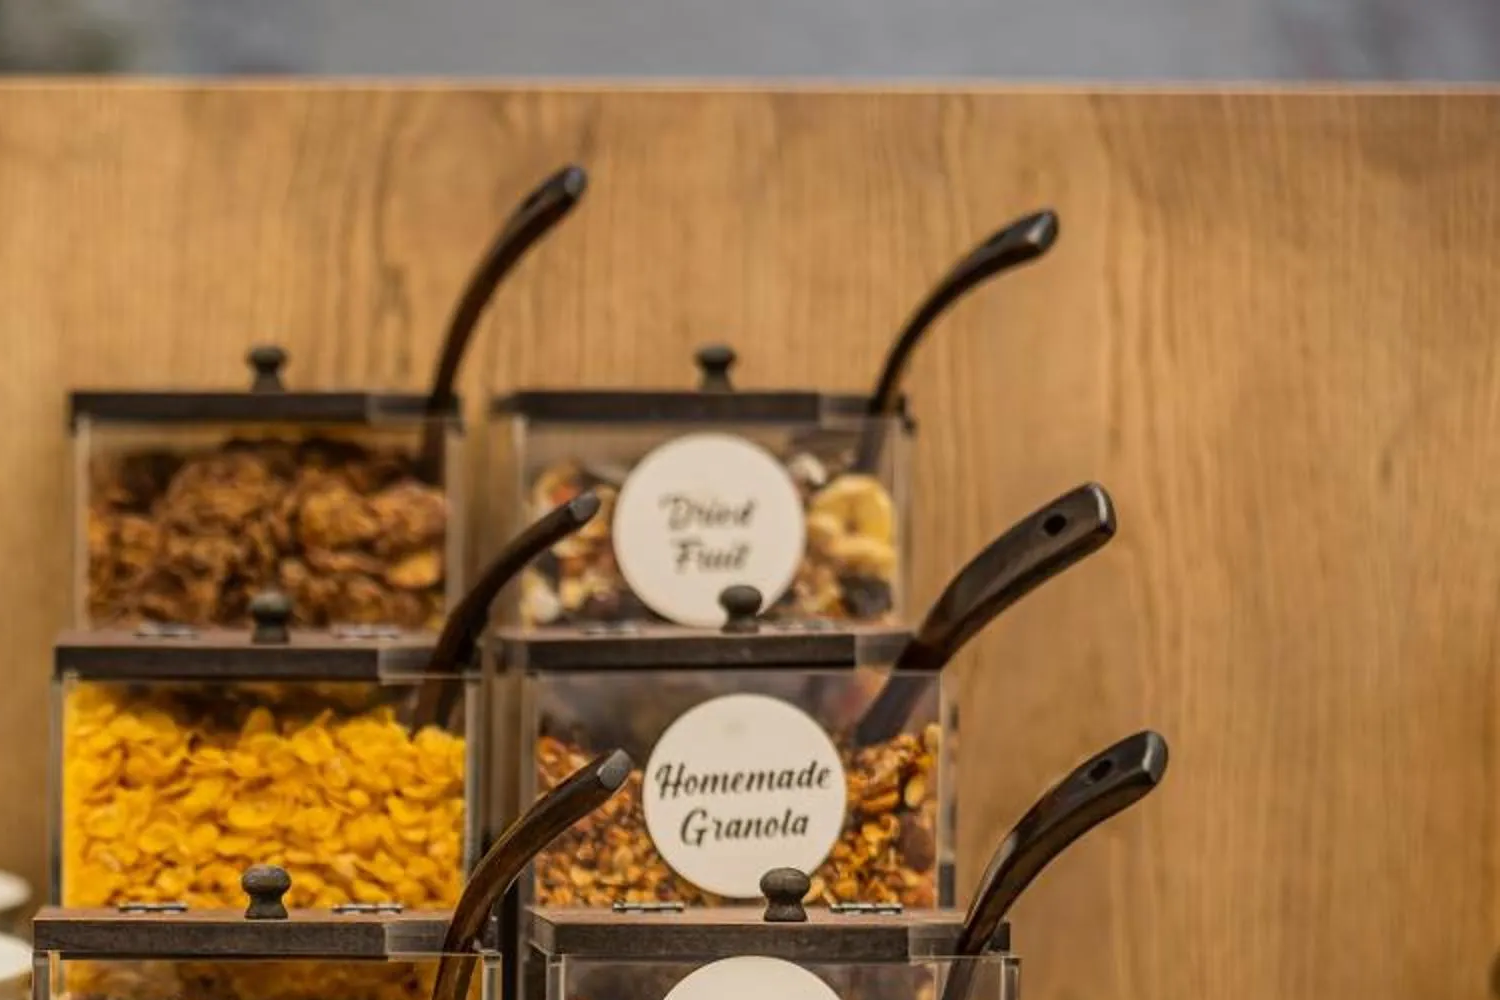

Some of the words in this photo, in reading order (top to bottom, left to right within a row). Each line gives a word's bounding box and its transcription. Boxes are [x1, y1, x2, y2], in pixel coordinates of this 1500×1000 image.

[658, 493, 758, 530] Dried
[670, 537, 750, 574] Fruit
[654, 760, 831, 799] Homemade
[680, 807, 810, 847] Granola
